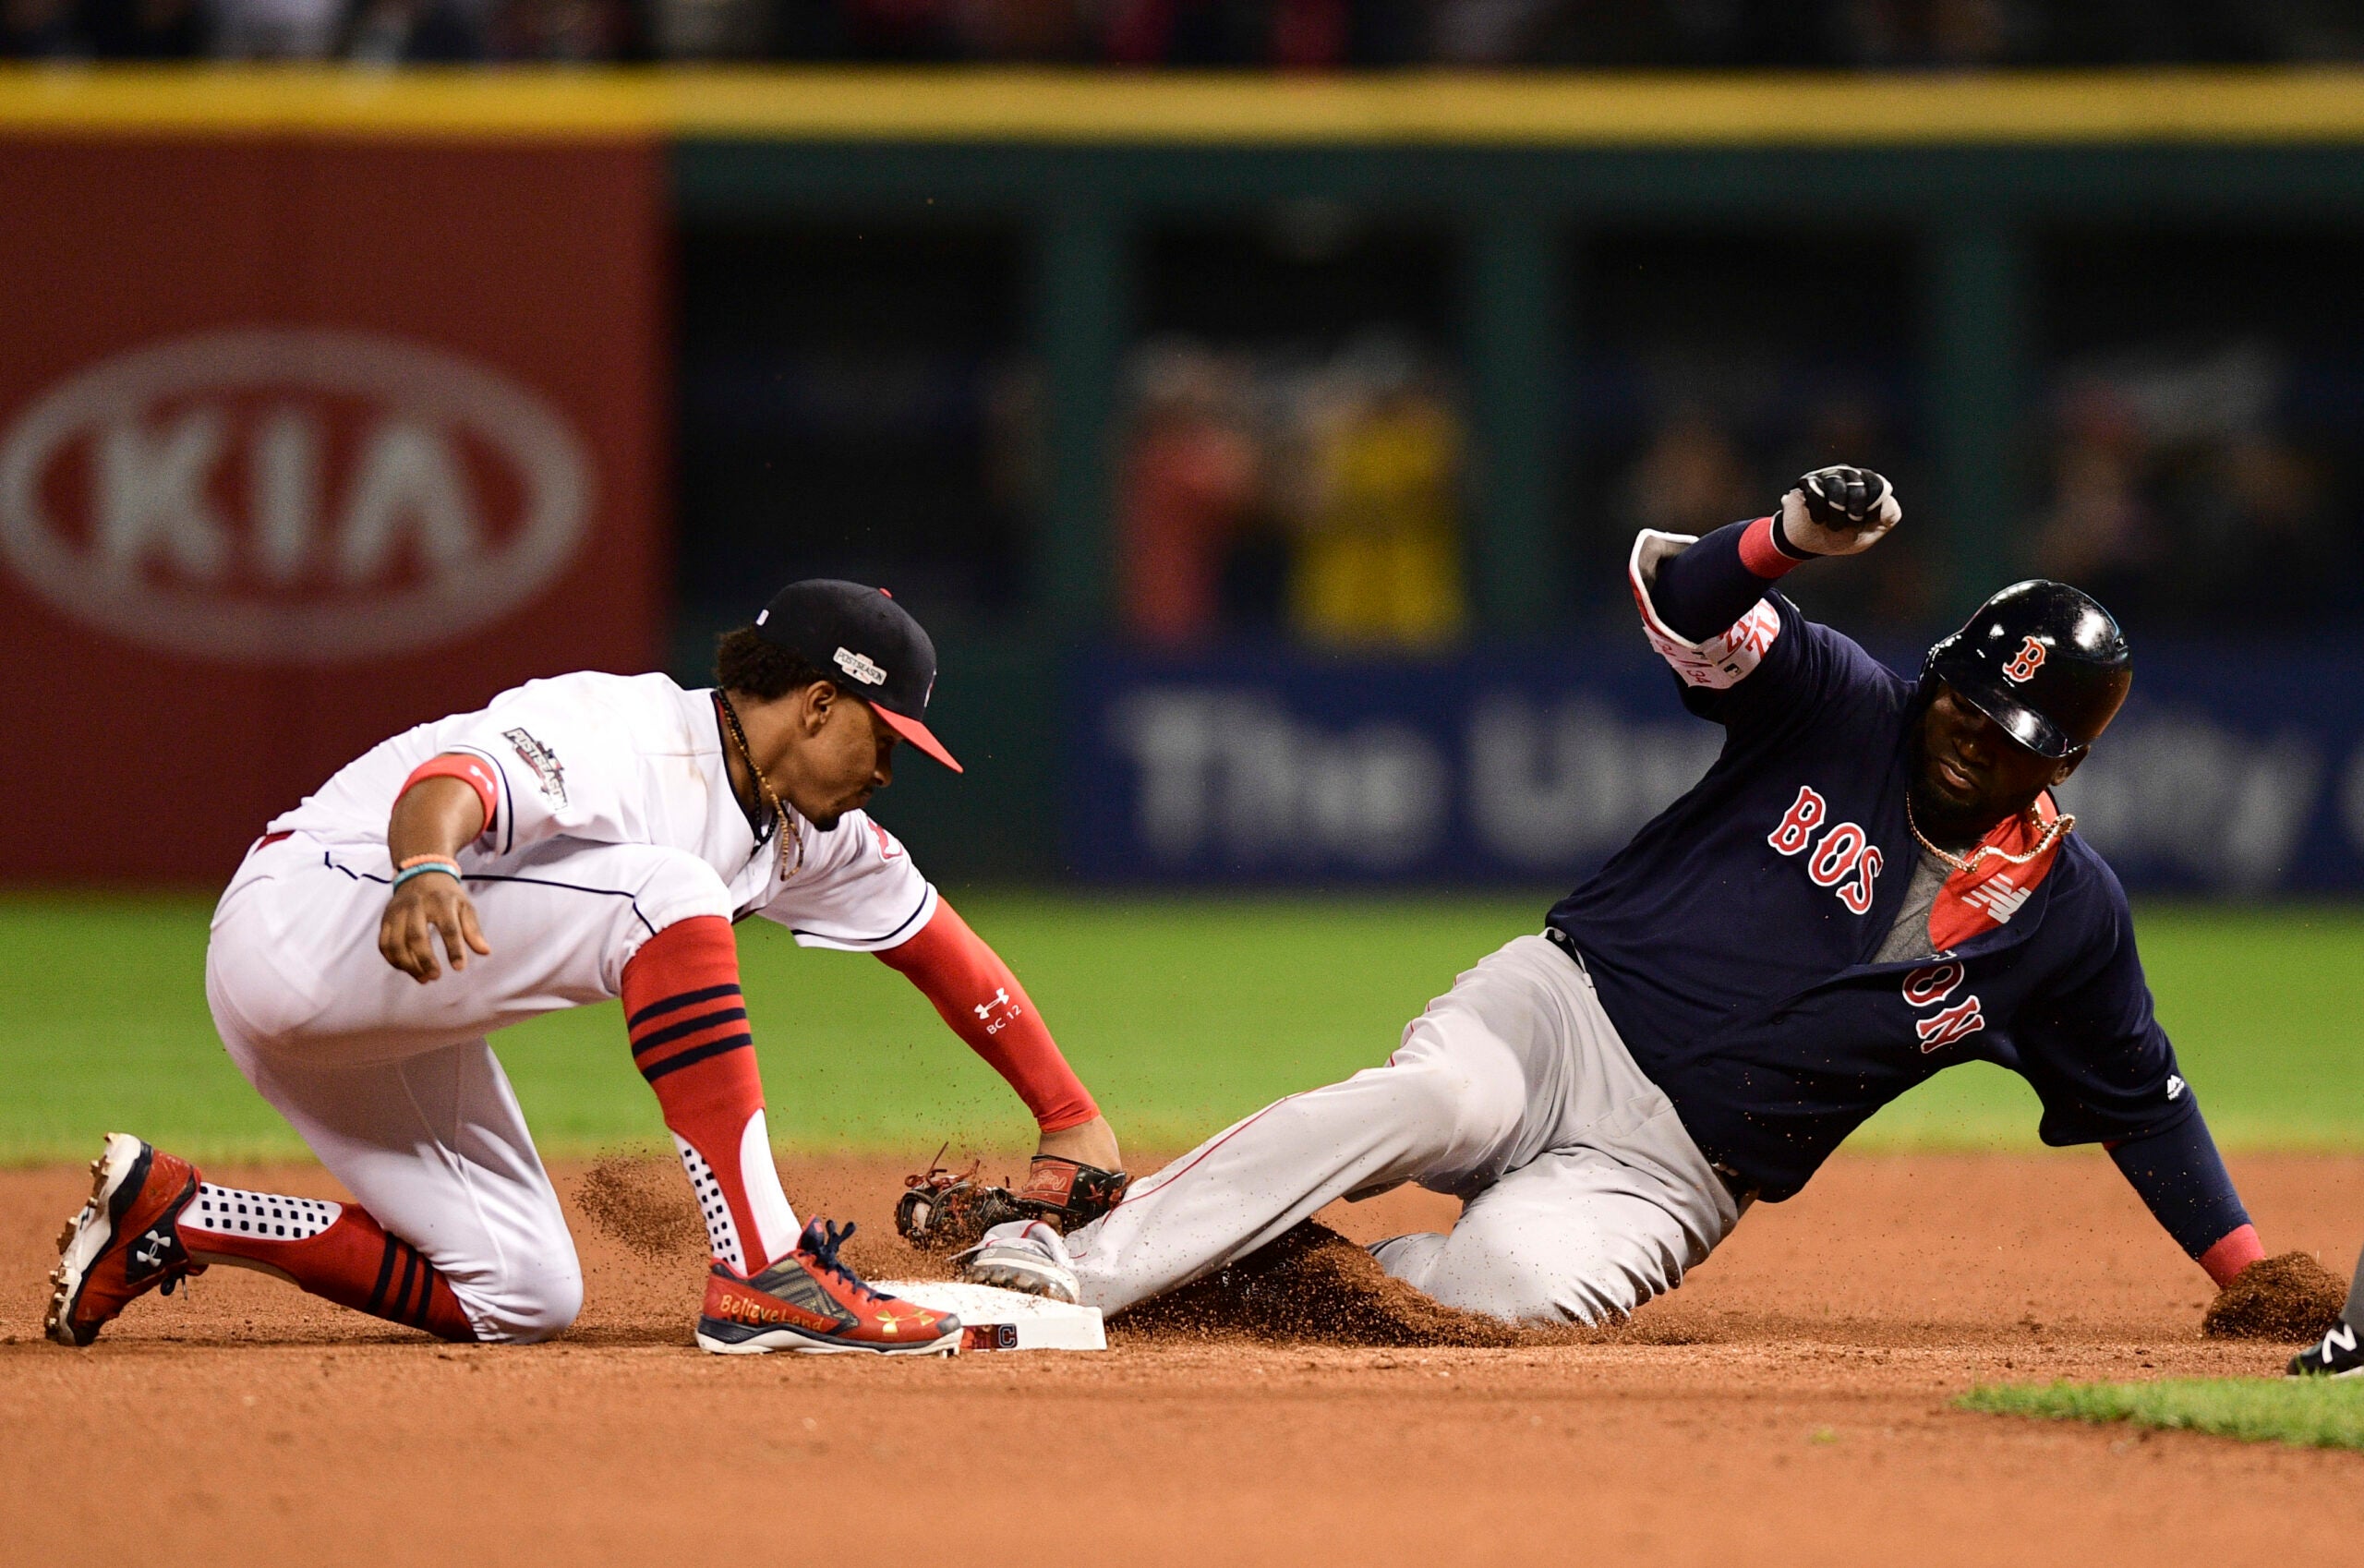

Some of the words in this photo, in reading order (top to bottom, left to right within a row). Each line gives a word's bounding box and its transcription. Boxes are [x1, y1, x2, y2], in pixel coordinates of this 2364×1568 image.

[98, 408, 481, 580] KIA
[836, 650, 884, 681] POSTSEASON
[2002, 635, 2045, 682] B
[986, 1017, 1006, 1034] BC
[1007, 1004, 1022, 1019] 12
[998, 1324, 1016, 1347] C
